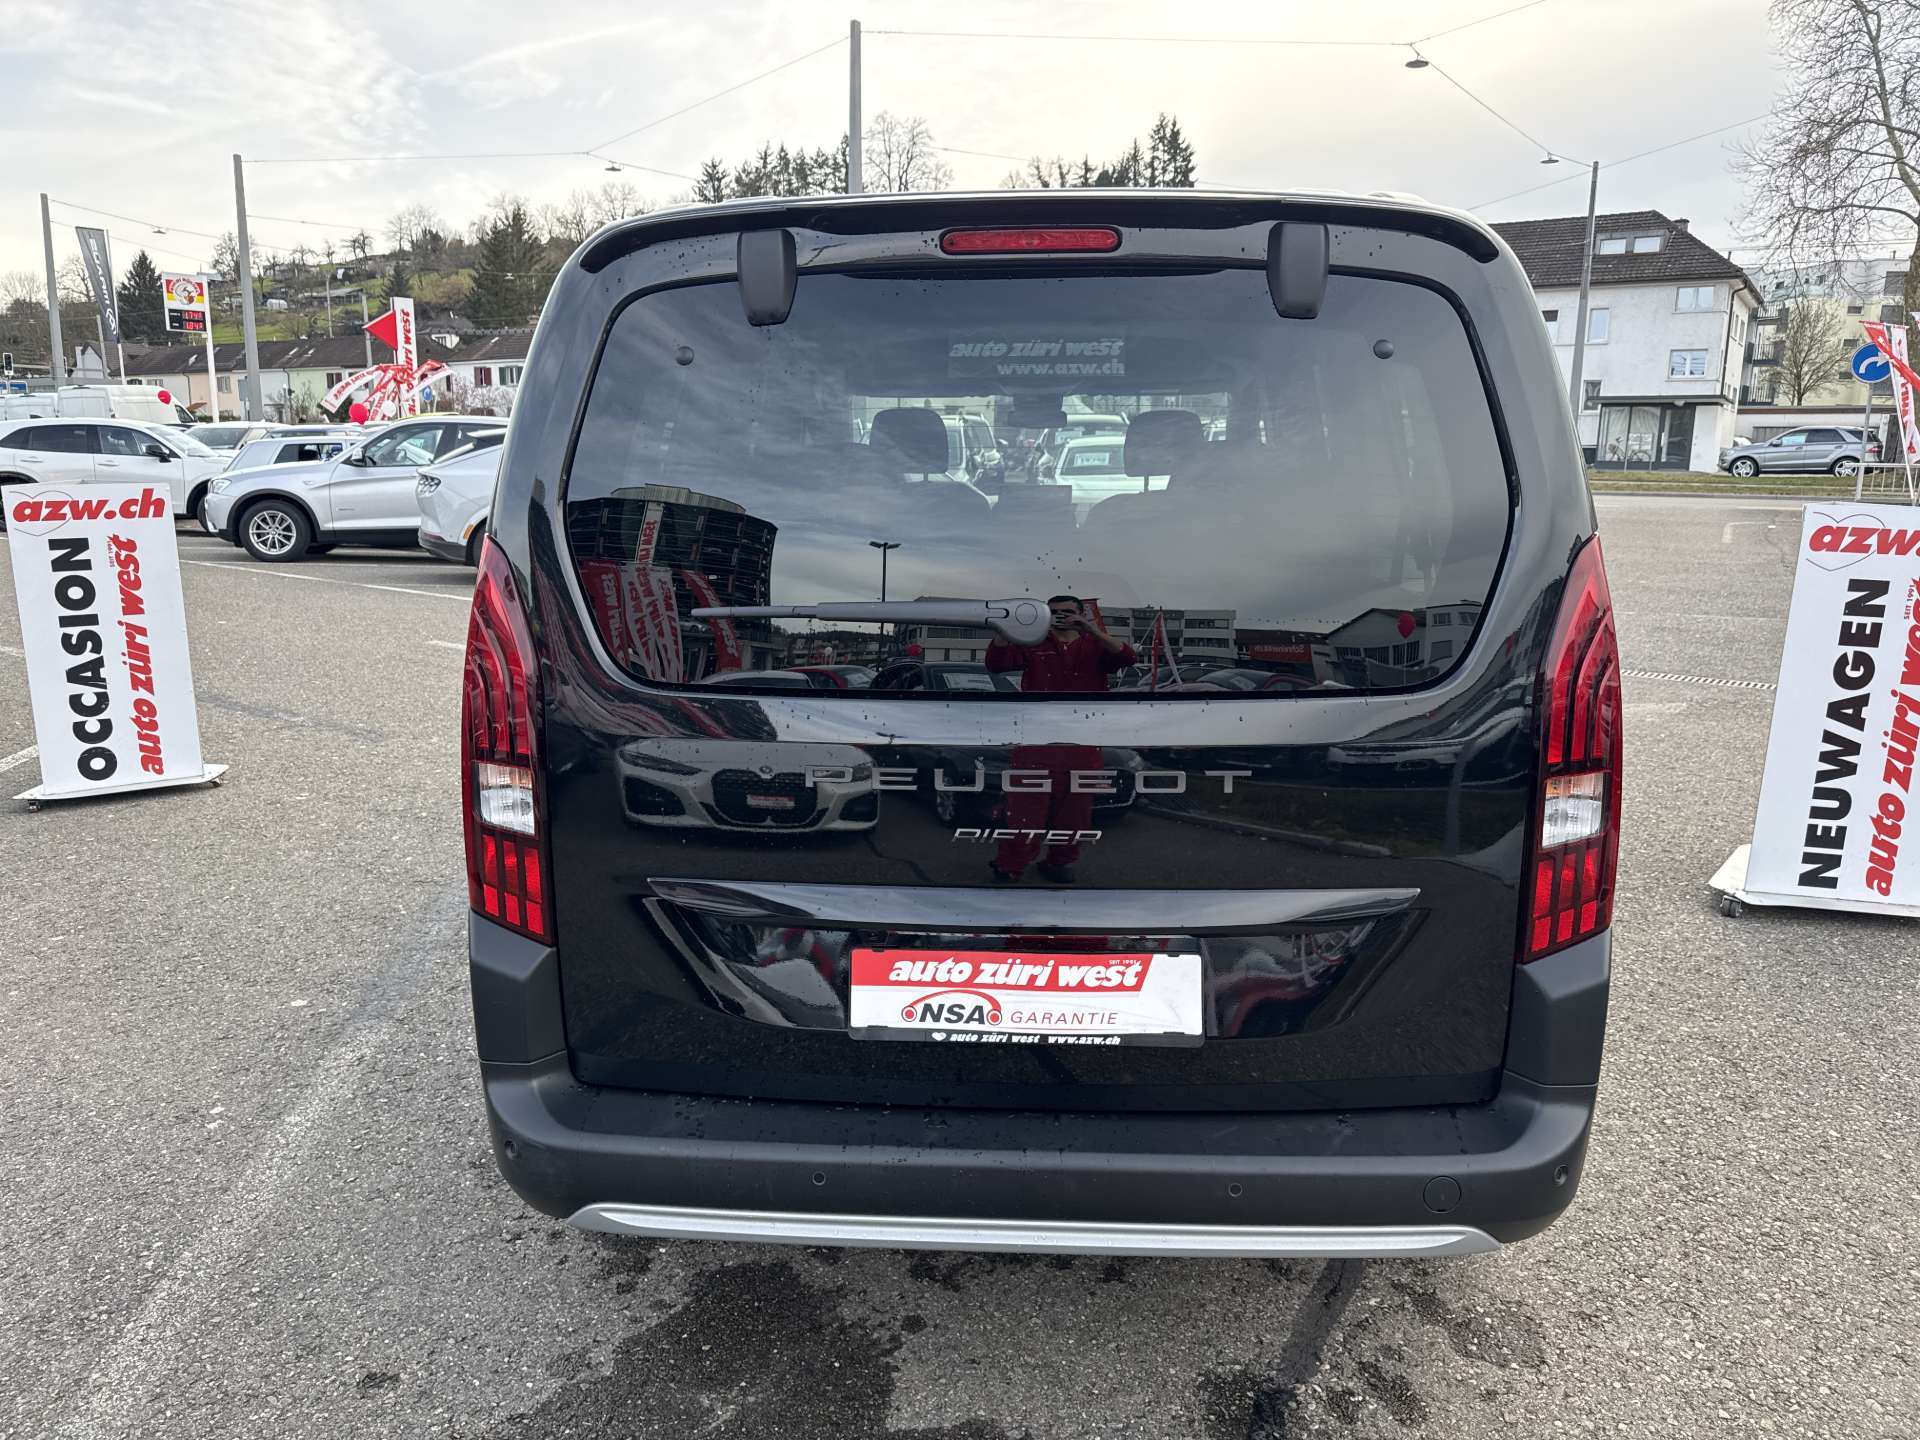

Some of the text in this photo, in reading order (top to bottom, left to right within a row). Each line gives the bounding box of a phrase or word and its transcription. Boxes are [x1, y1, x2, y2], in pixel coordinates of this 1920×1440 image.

[401, 309, 412, 345] west
[950, 339, 1125, 357] auto züri west
[997, 358, 1125, 375] www.azw.ch
[12, 488, 166, 523] azw.ch
[1809, 525, 1920, 557] azw
[1907, 584, 1915, 601] 1991
[48, 537, 117, 781] OCCASION
[106, 534, 164, 775] auto züri west
[1798, 578, 1891, 890] NEUWAGEN
[1881, 689, 1920, 794] züri
[804, 767, 1253, 794] PEUGEOT
[951, 828, 1103, 846] RIFTER
[1866, 792, 1905, 897] auto
[889, 957, 1143, 988] auto züri west
[919, 1003, 1119, 1025] NSA GARANTIE
[950, 1032, 1121, 1045] auto züri west www.azw.ch
